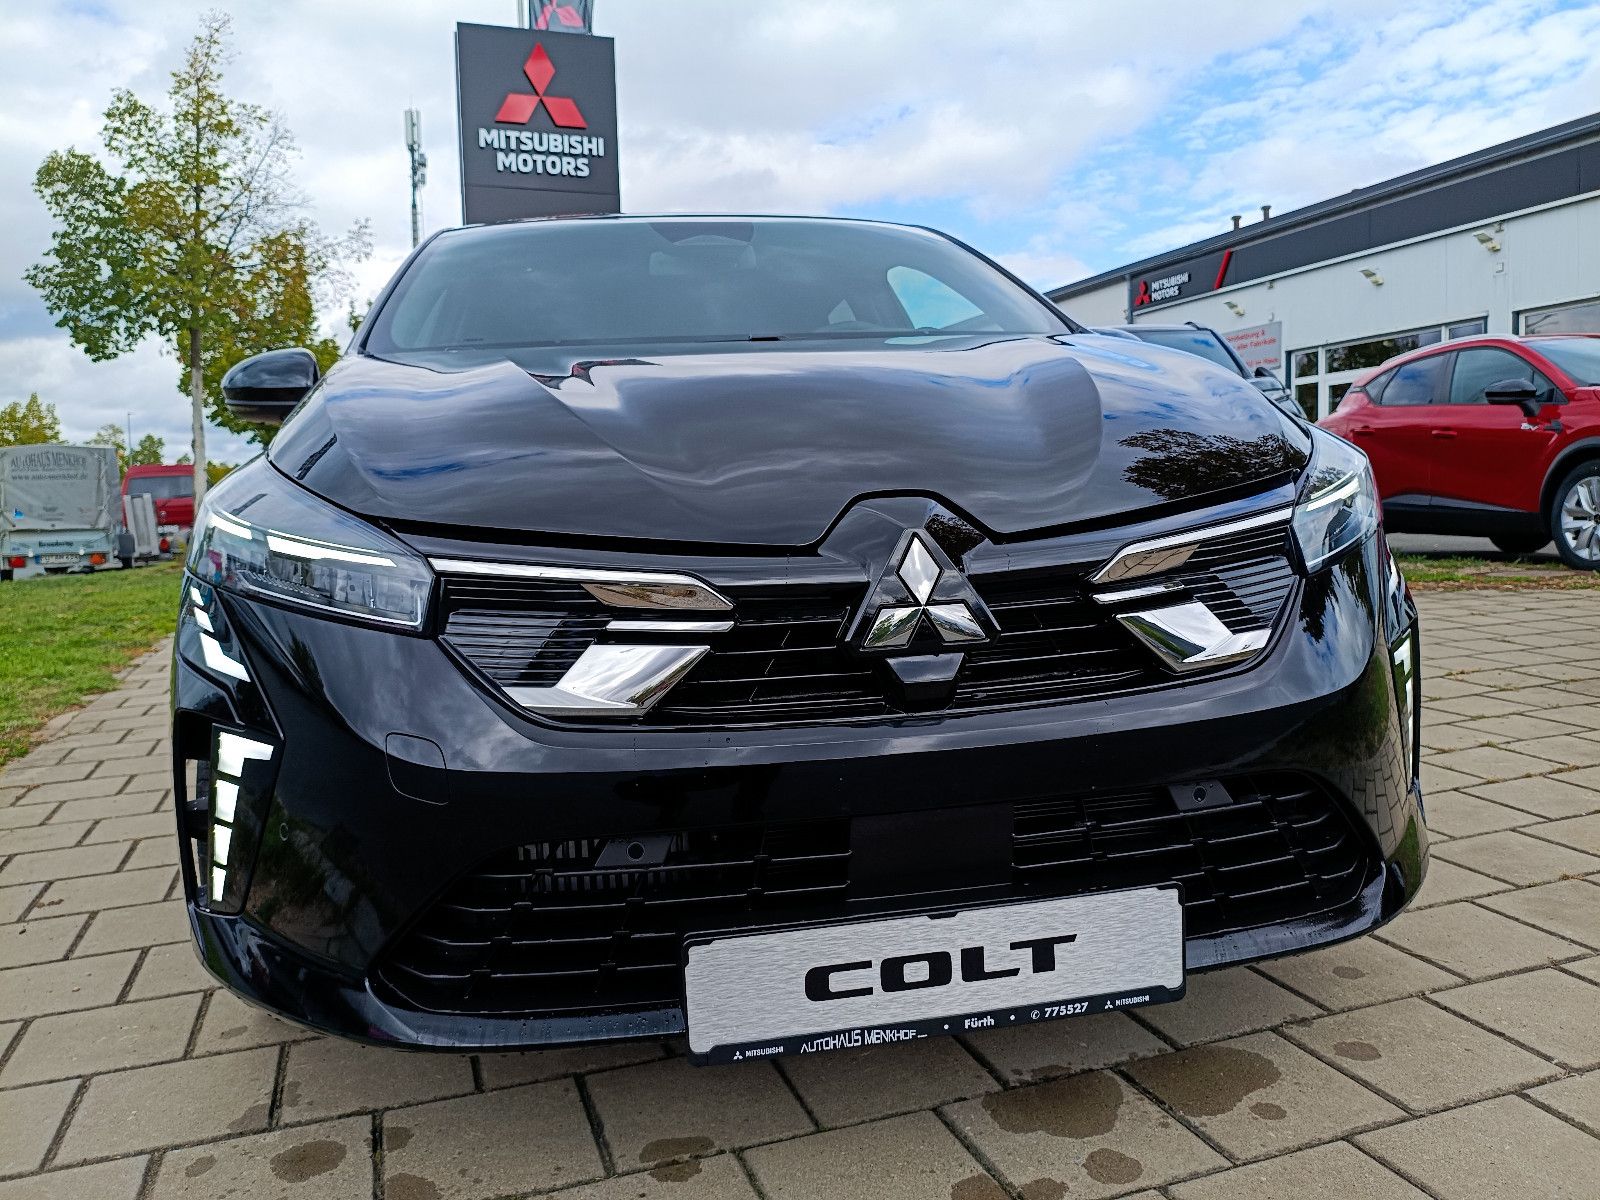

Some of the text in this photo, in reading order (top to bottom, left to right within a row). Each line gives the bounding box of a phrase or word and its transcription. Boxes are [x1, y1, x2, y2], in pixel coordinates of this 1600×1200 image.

[478, 127, 605, 157] MITSUBISHI
[496, 152, 590, 178] MOTORS
[1151, 271, 1189, 291] MITSUBISHI
[1151, 285, 1180, 301] MOTORS
[804, 933, 1079, 1002] COLT
[745, 1045, 784, 1058] MITSUBISHI
[800, 1029, 862, 1054] AUTOHAUS
[964, 1015, 995, 1029] Fürth
[1044, 1001, 1089, 1018] 775527
[1115, 994, 1150, 1007] MITSUBISHI
